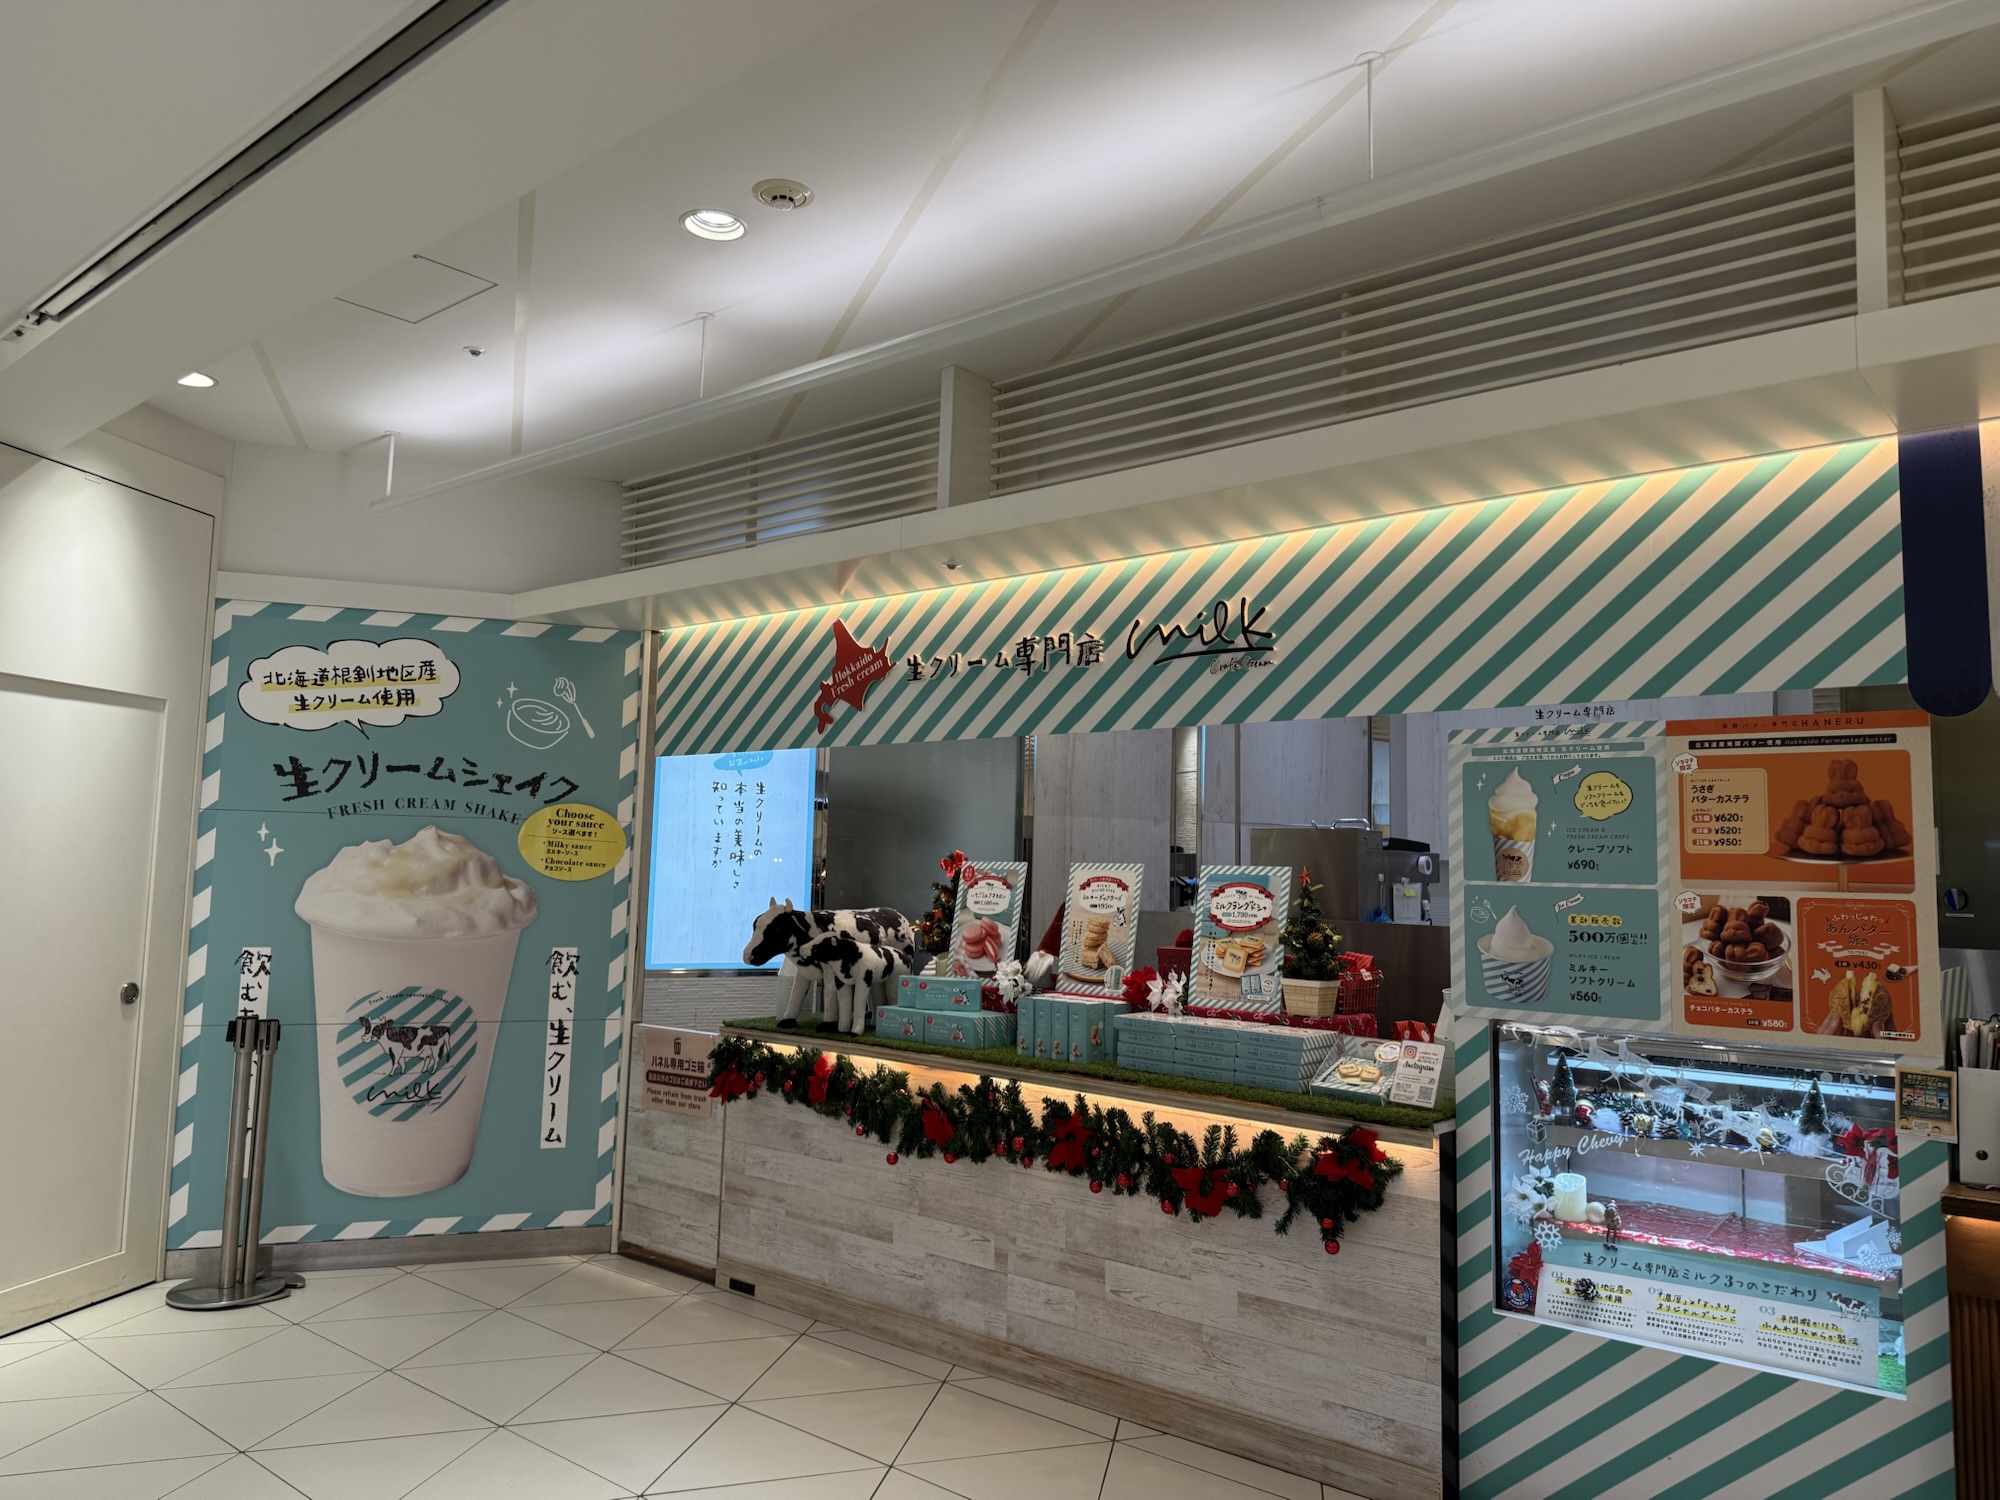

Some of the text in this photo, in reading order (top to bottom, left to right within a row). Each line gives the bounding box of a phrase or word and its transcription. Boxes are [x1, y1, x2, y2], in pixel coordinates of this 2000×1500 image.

[1126, 597, 1276, 666] milk
[906, 632, 1106, 682] 生クリーム専門店
[263, 660, 437, 687] 北海道根釧地区産
[832, 652, 874, 684] Hokkaido
[828, 658, 884, 699] Fresh cream
[294, 687, 416, 711] 生クリーム使用
[1535, 705, 1615, 720] 生クリーム専門店
[1801, 716, 1864, 727] HANERU
[1784, 737, 1819, 746] Hokkaido
[1820, 736, 1864, 745] Fermented
[1865, 734, 1893, 743] butter
[1679, 763, 1692, 771] 限定
[273, 751, 580, 804] 生クリームシェイク
[1691, 784, 1715, 794] うさぎ
[1691, 794, 1750, 804] バターカステラ
[327, 797, 522, 826] FRESH CREAM SHAKE
[556, 808, 595, 820] Choose
[548, 818, 605, 829] your sauce
[712, 781, 728, 869] 知っていますか
[754, 782, 766, 857] 生クリームの
[730, 782, 747, 889] 本当の美味しさ
[547, 841, 569, 850] Milky
[545, 858, 583, 868] Chocolate
[1215, 900, 1267, 913] ミルクラングドシャ
[1848, 935, 1870, 946] 焼き
[1569, 963, 1608, 973] ミルキー
[1569, 976, 1636, 988] ソフトクリーム
[1690, 1004, 1753, 1016] チョコバターカステラ
[545, 950, 581, 1143] 飲む、生クリーム
[651, 1055, 705, 1075] ハネル専用ゴミ箱
[1403, 1061, 1434, 1074] Instagram
[367, 1081, 442, 1106] milk
[647, 1087, 707, 1103] Please refrain from trash
[652, 1096, 664, 1104] other
[665, 1098, 676, 1106] than
[688, 1102, 701, 1111] store
[1518, 1146, 1573, 1166] Happy
[1656, 1302, 1736, 1323] オリジナルブレンド
[1759, 1305, 1776, 1315] 03
